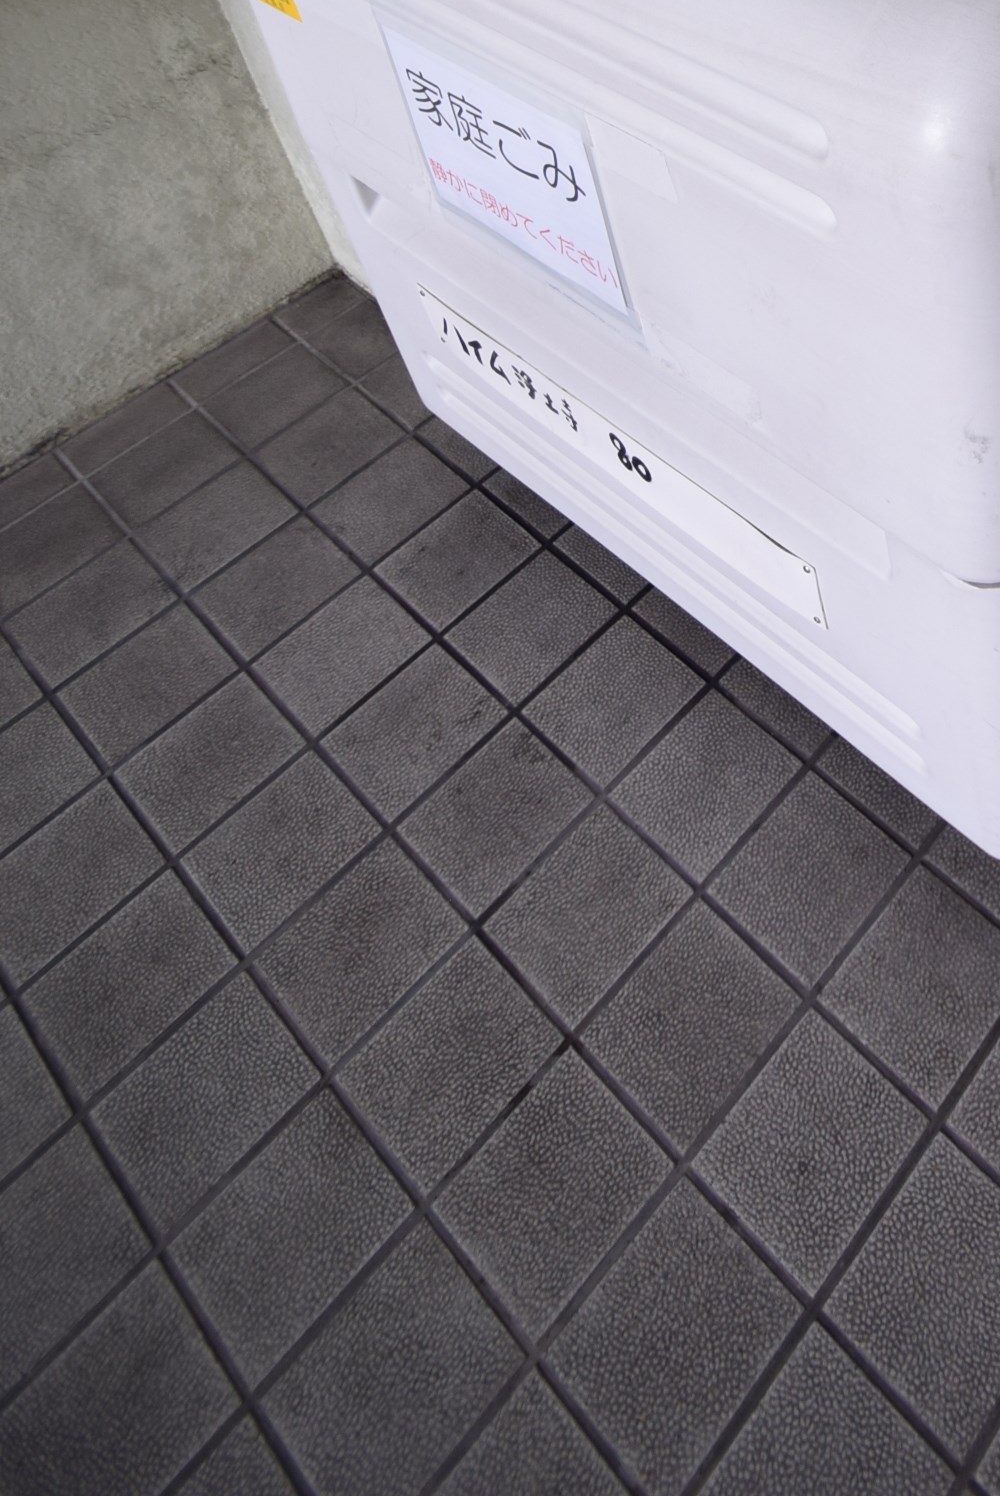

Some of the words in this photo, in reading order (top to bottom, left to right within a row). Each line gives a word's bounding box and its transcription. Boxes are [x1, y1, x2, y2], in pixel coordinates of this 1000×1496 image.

[406, 68, 587, 202] 家庭ごみ
[429, 157, 618, 288] 静かに閉めてください
[609, 432, 652, 483] 80
